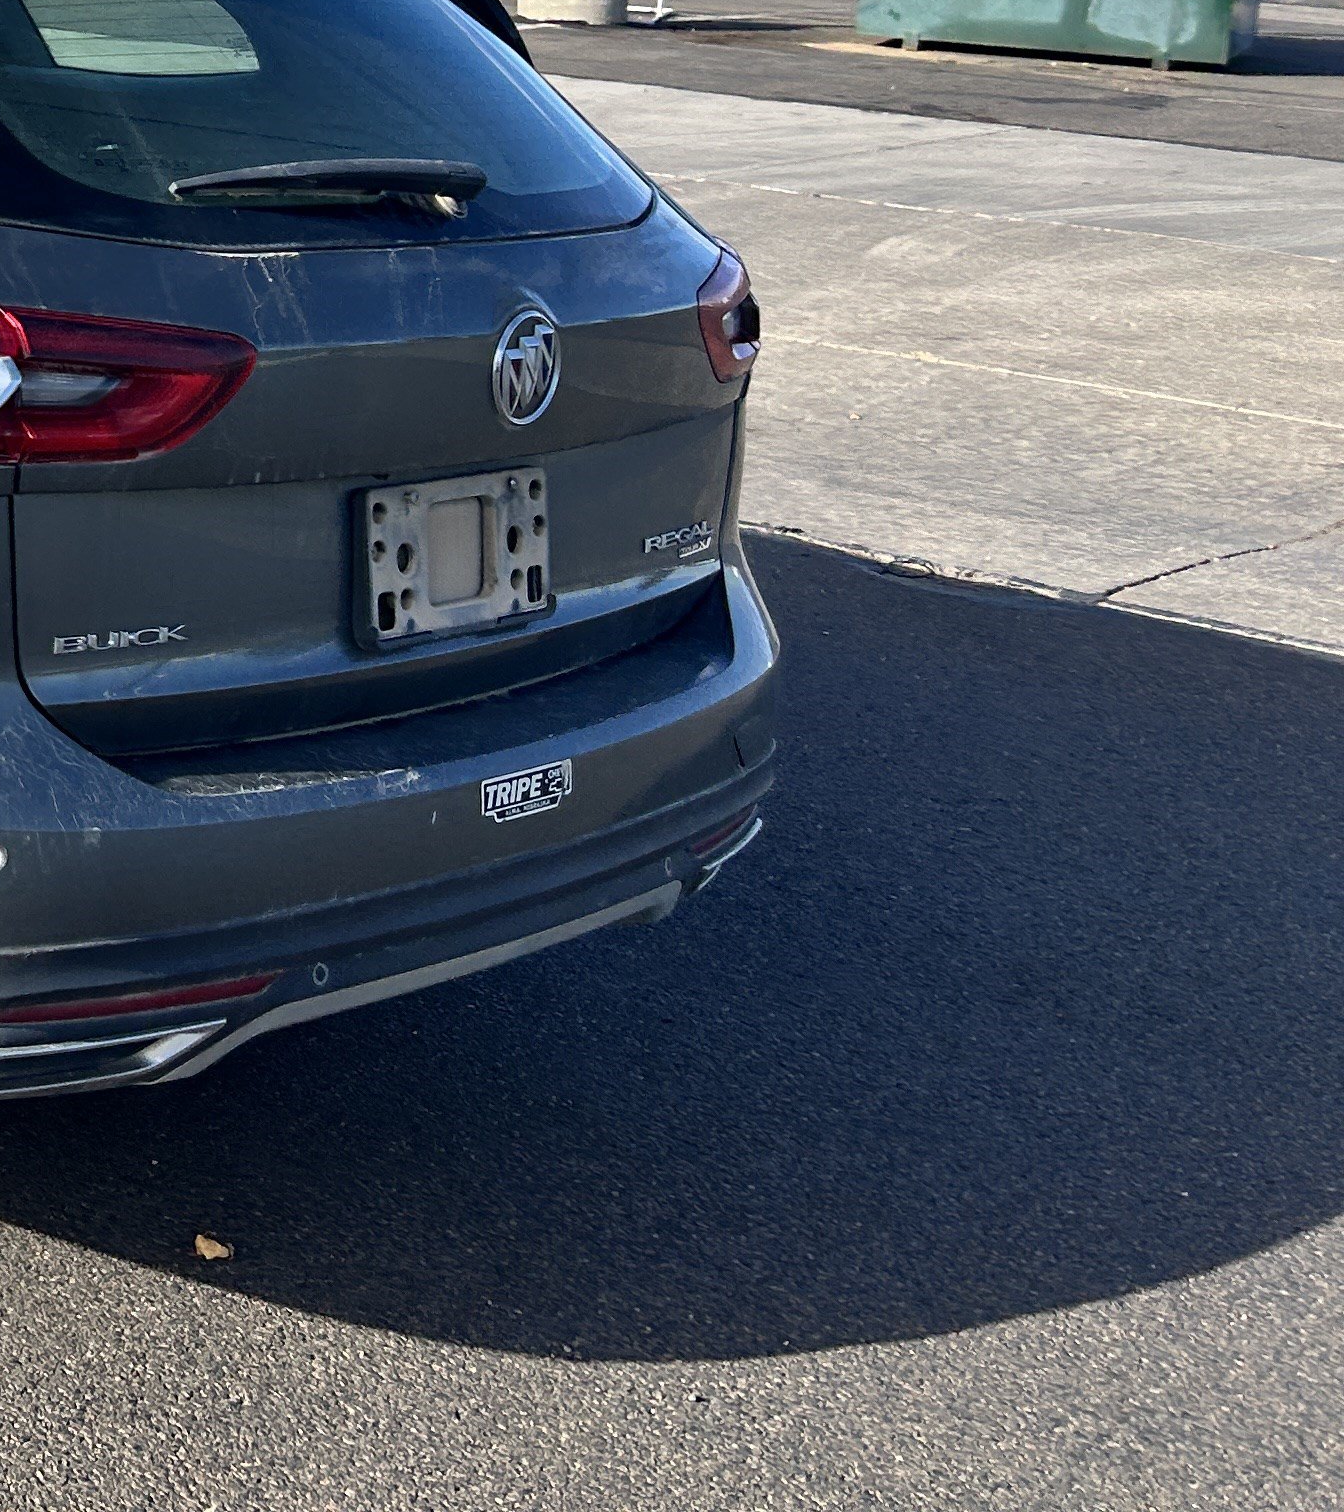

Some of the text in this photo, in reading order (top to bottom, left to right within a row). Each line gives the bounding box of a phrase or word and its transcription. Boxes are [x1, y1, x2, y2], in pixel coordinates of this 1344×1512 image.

[644, 520, 714, 554] REGAL
[53, 624, 189, 655] BUICK
[485, 772, 543, 810] TRIPE
